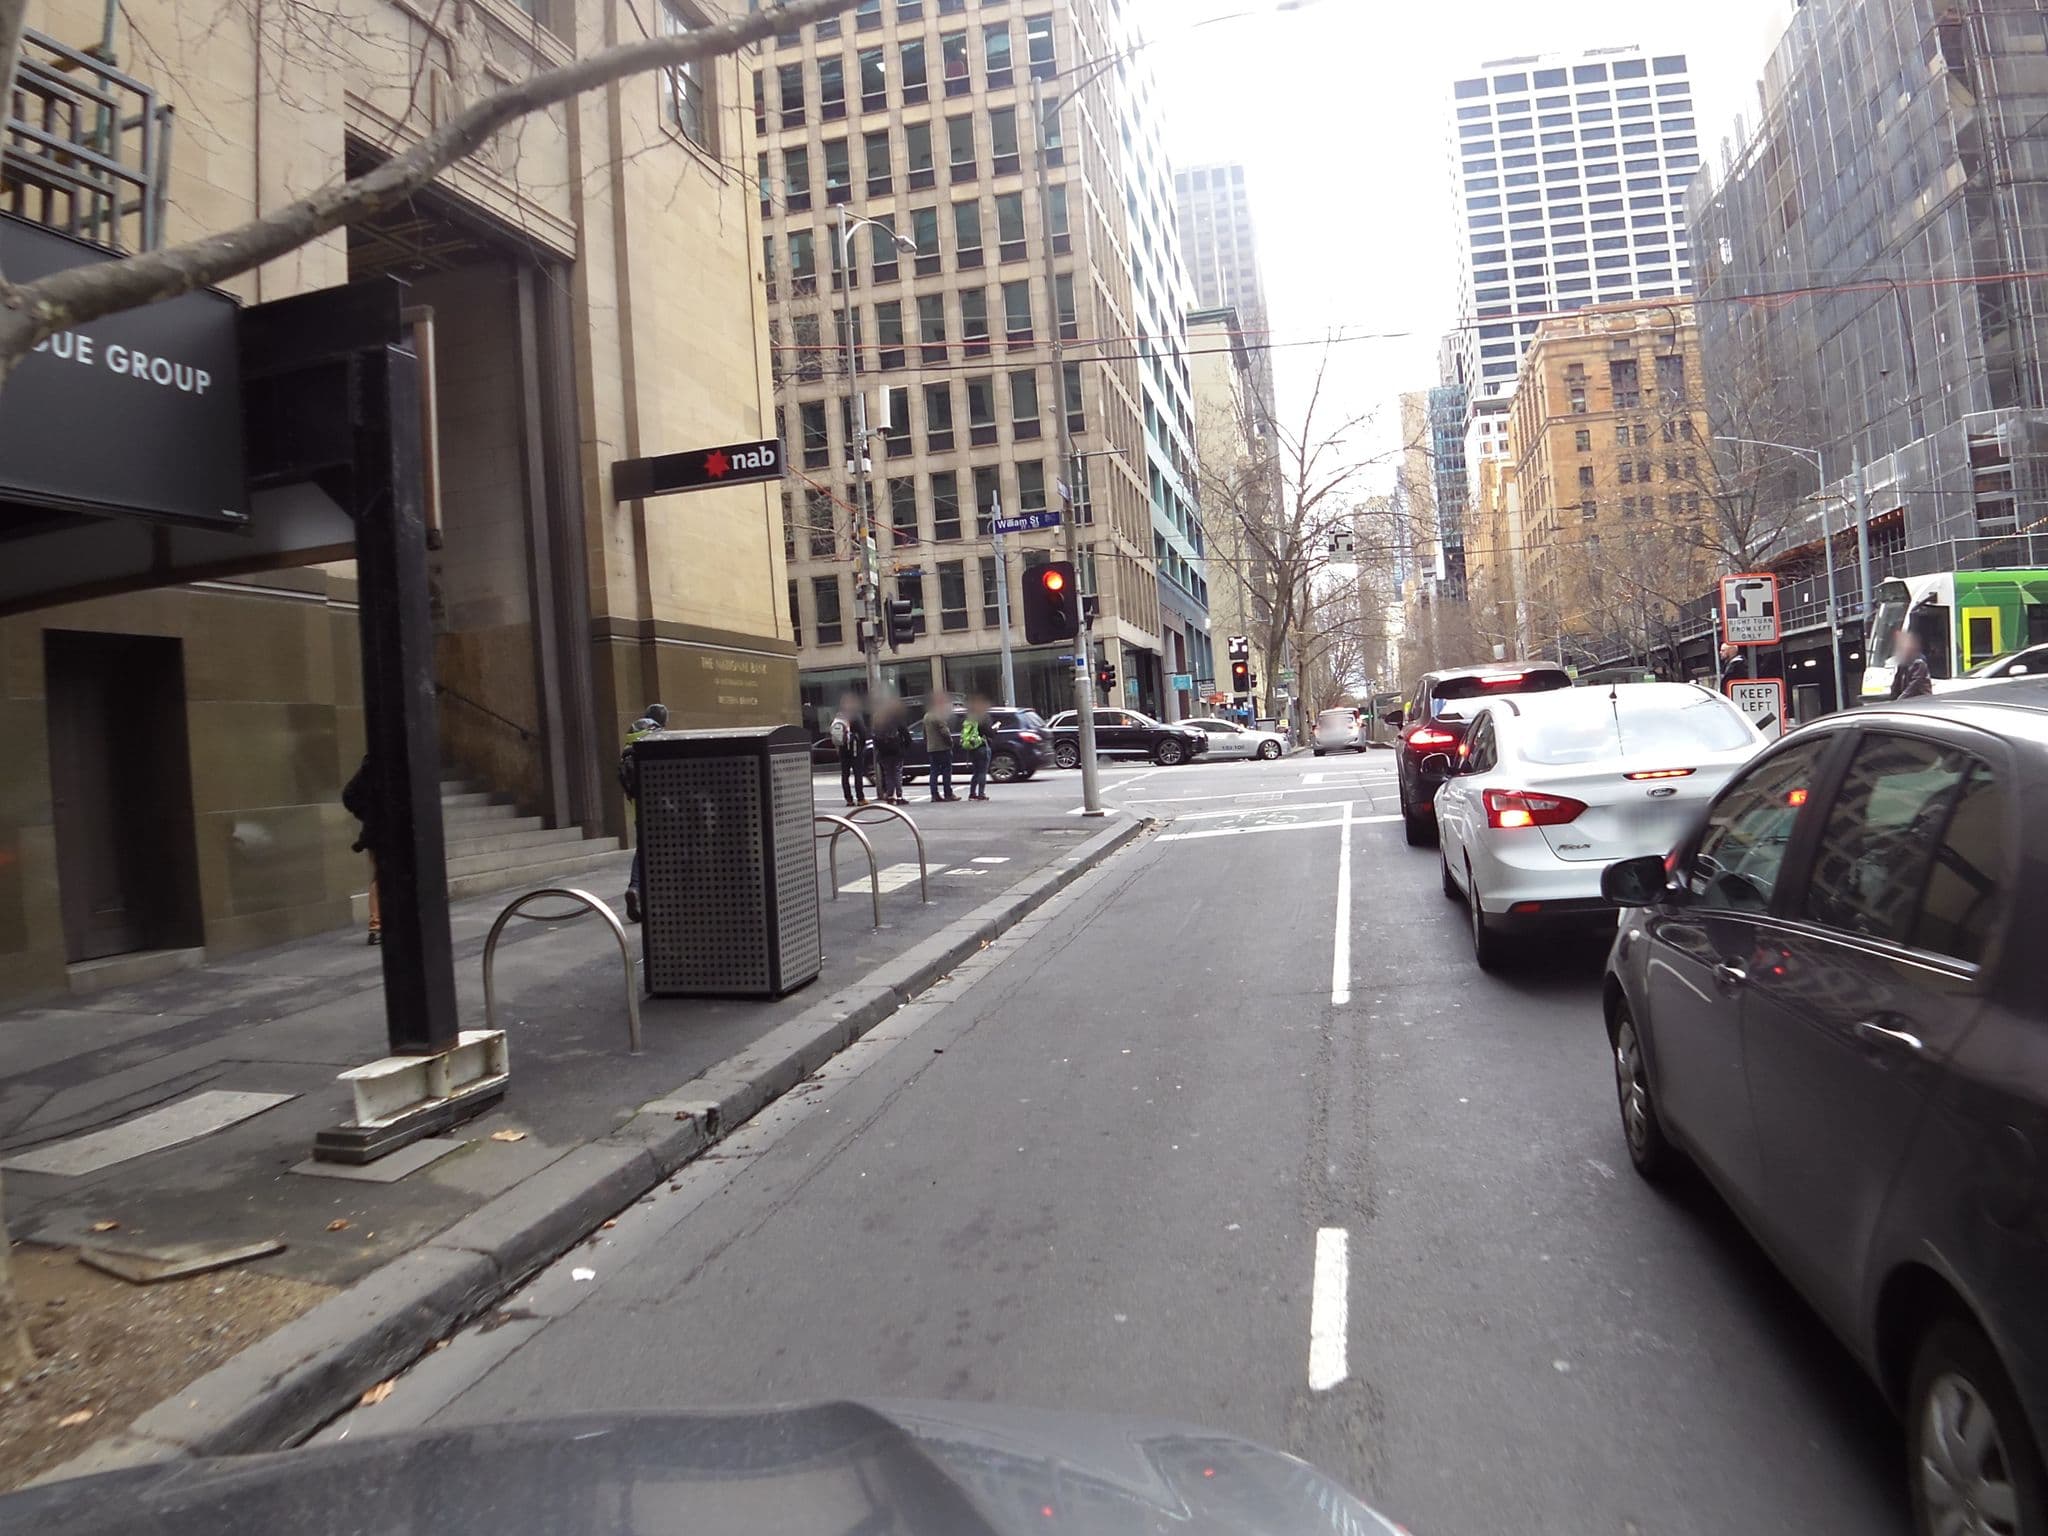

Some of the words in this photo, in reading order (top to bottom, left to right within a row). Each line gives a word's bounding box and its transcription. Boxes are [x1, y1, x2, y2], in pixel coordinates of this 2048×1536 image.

[105, 344, 212, 395] GROUP
[731, 446, 775, 470] nab
[997, 518, 1027, 529] William
[1029, 515, 1040, 525] St
[1740, 688, 1773, 699] KEEP
[1742, 701, 1772, 712] LEFT
